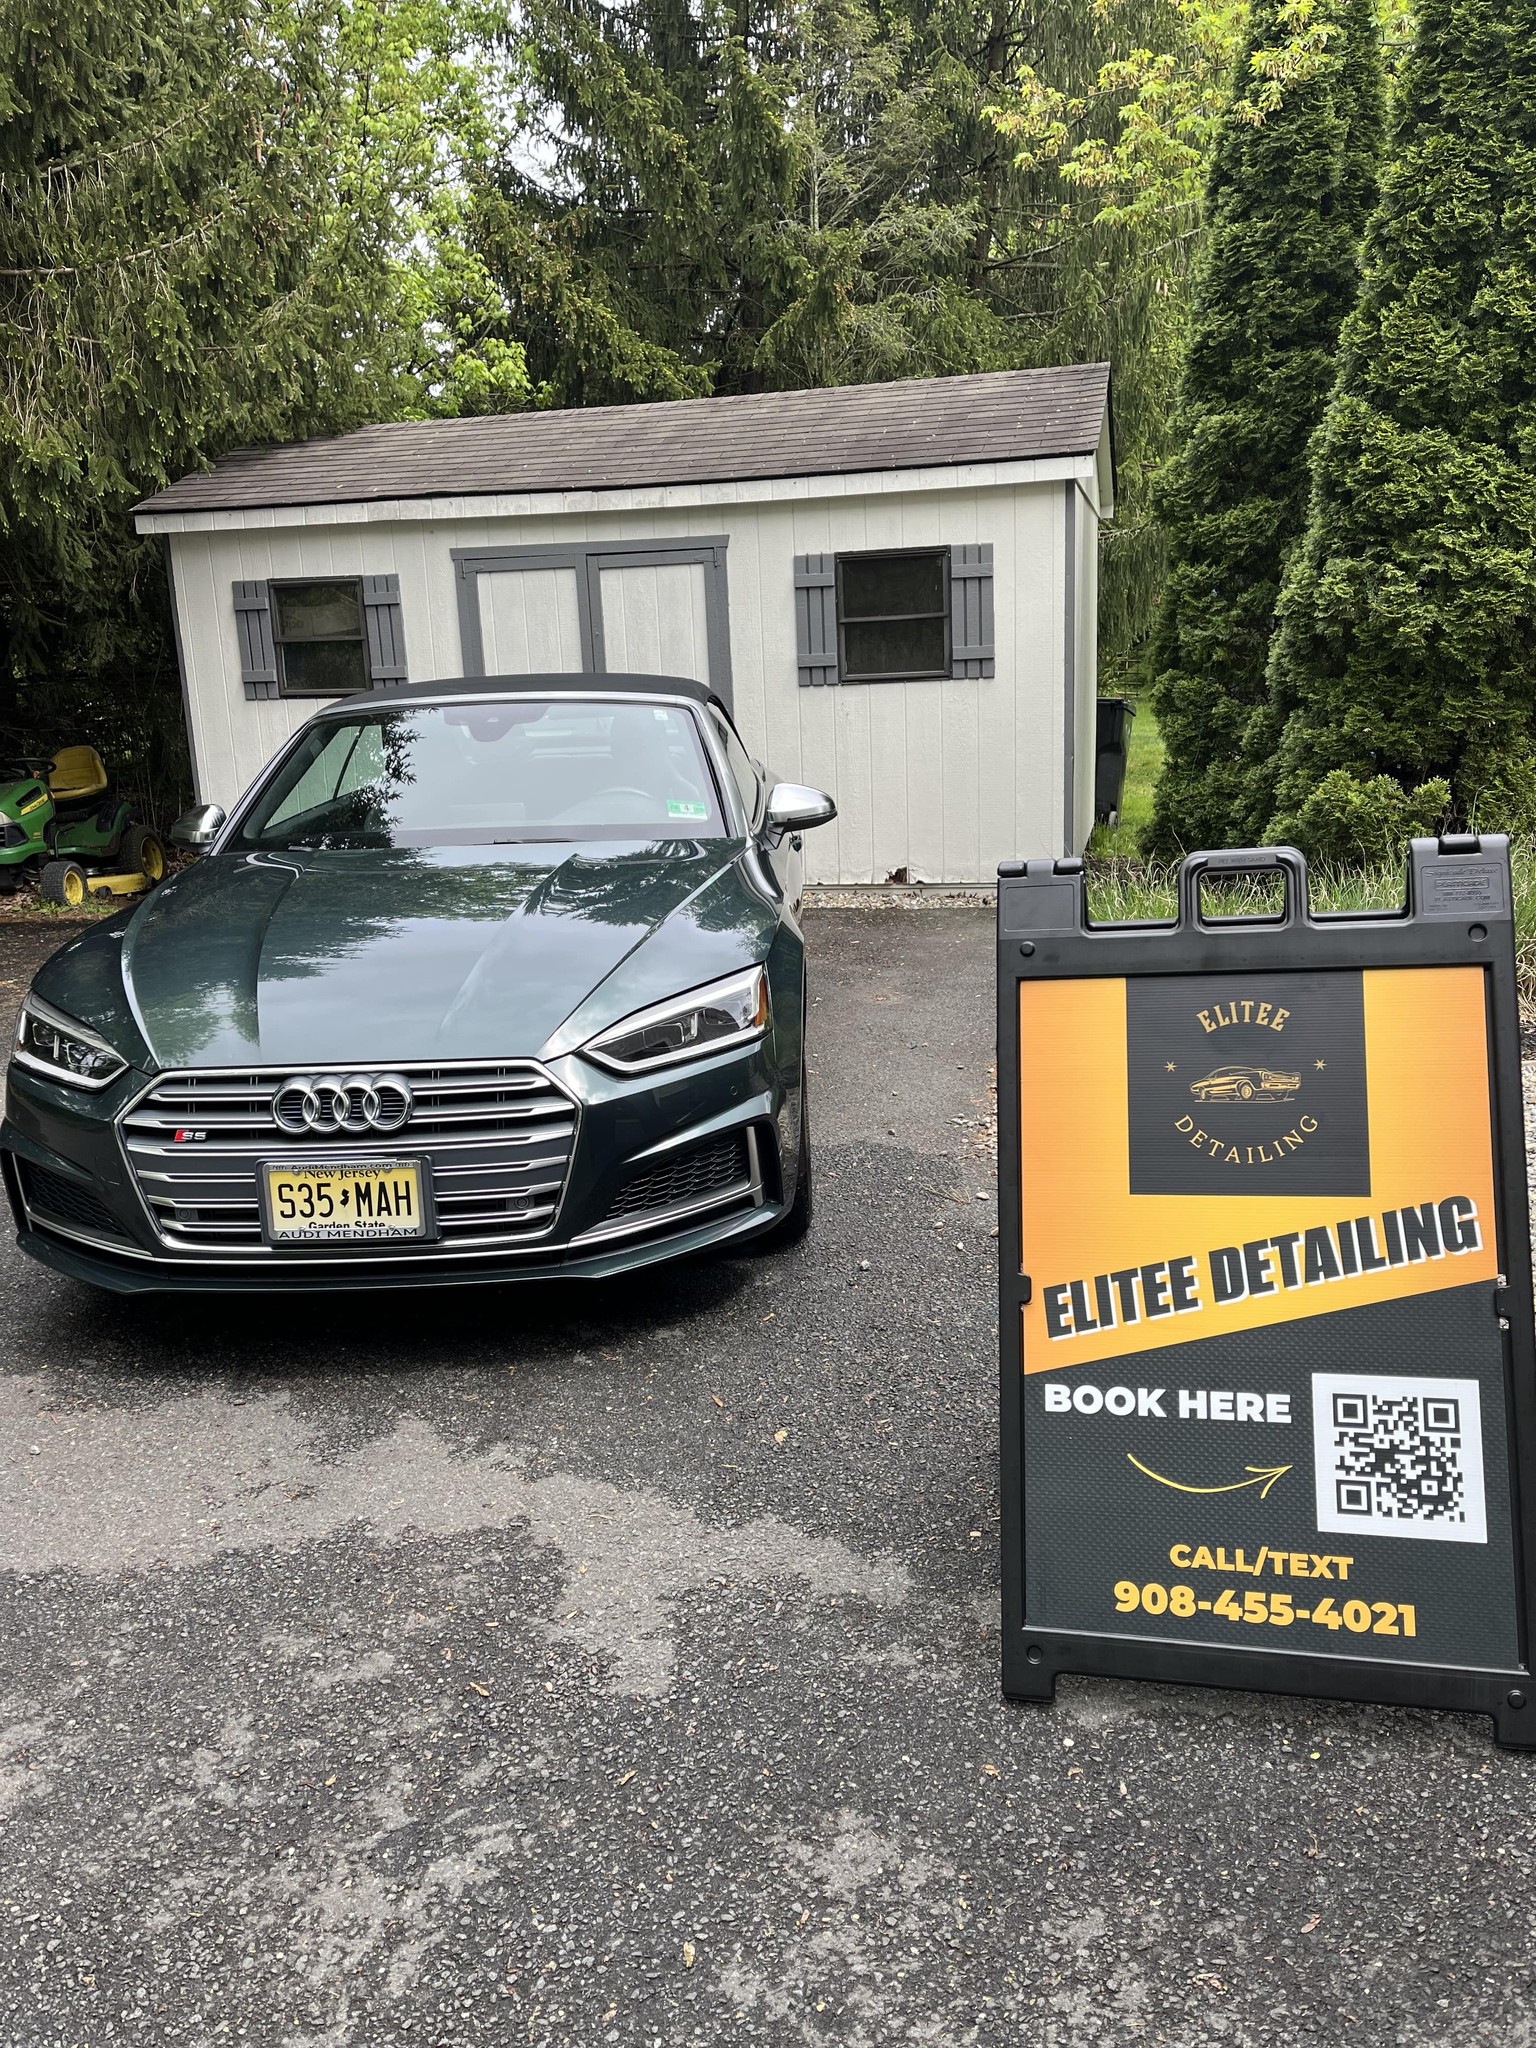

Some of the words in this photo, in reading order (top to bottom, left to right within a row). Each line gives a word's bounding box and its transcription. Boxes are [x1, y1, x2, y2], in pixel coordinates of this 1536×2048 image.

[1196, 1000, 1290, 1033] ELITEE
[1174, 1115, 1318, 1163] DETAILING
[304, 1169, 337, 1179] New
[338, 1169, 380, 1181] Jersey
[277, 1183, 334, 1218] S35
[354, 1181, 412, 1217] MAH
[278, 1230, 321, 1239] AUDI
[327, 1228, 418, 1238] MENDHAM
[308, 1221, 350, 1229] Garden
[354, 1220, 386, 1228] State
[1043, 1255, 1203, 1341] ELITEE
[1208, 1195, 1484, 1306] DETAILING
[1043, 1383, 1168, 1419] BOOK
[1178, 1389, 1292, 1424] HERE
[1169, 1544, 1354, 1581] CALL/TEXT
[1113, 1580, 1417, 1637] 908-455-4021
